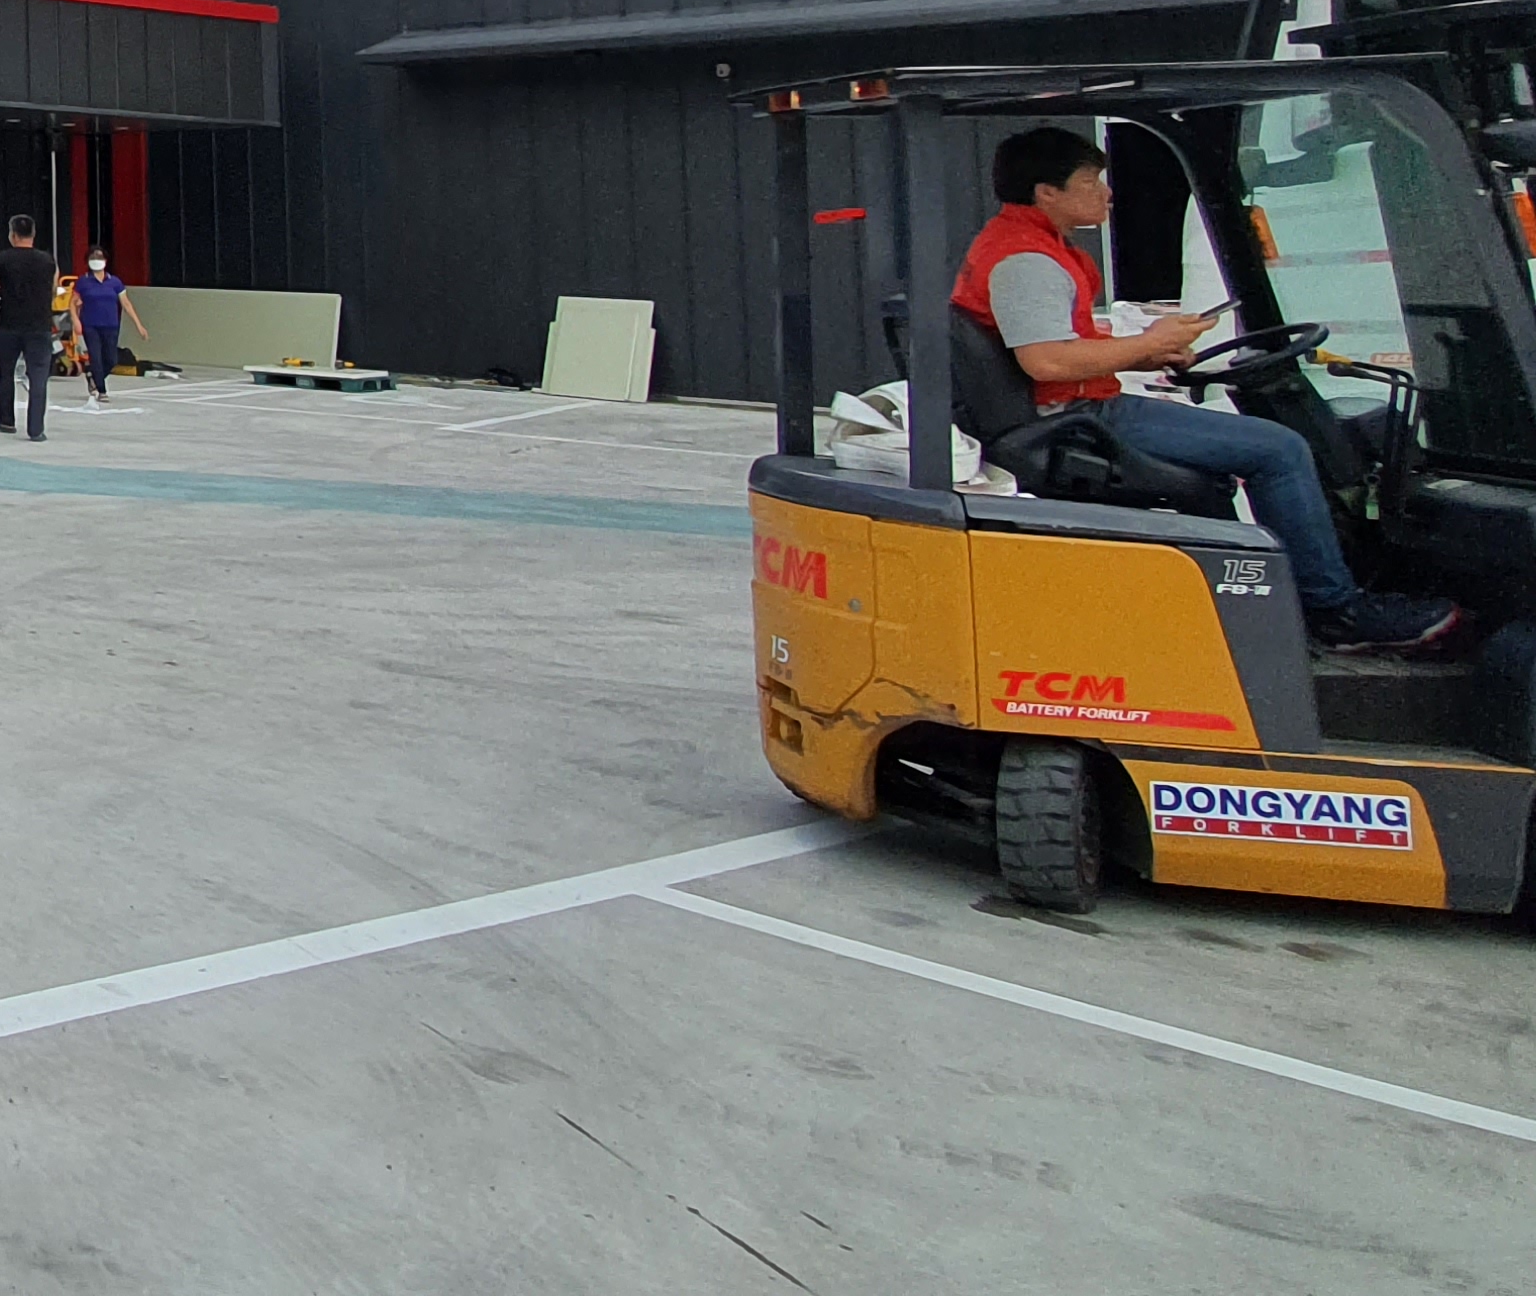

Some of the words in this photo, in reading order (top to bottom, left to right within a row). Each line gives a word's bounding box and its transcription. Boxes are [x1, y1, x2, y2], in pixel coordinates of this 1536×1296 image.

[1223, 559, 1267, 584] 15
[771, 635, 790, 663] 15
[998, 670, 1127, 703] TCM
[1006, 701, 1074, 719] BATTERY
[1078, 706, 1151, 723] FORKLIFT
[1153, 784, 1408, 827] DONGYANG
[1161, 816, 1402, 846] FORKLIFT
